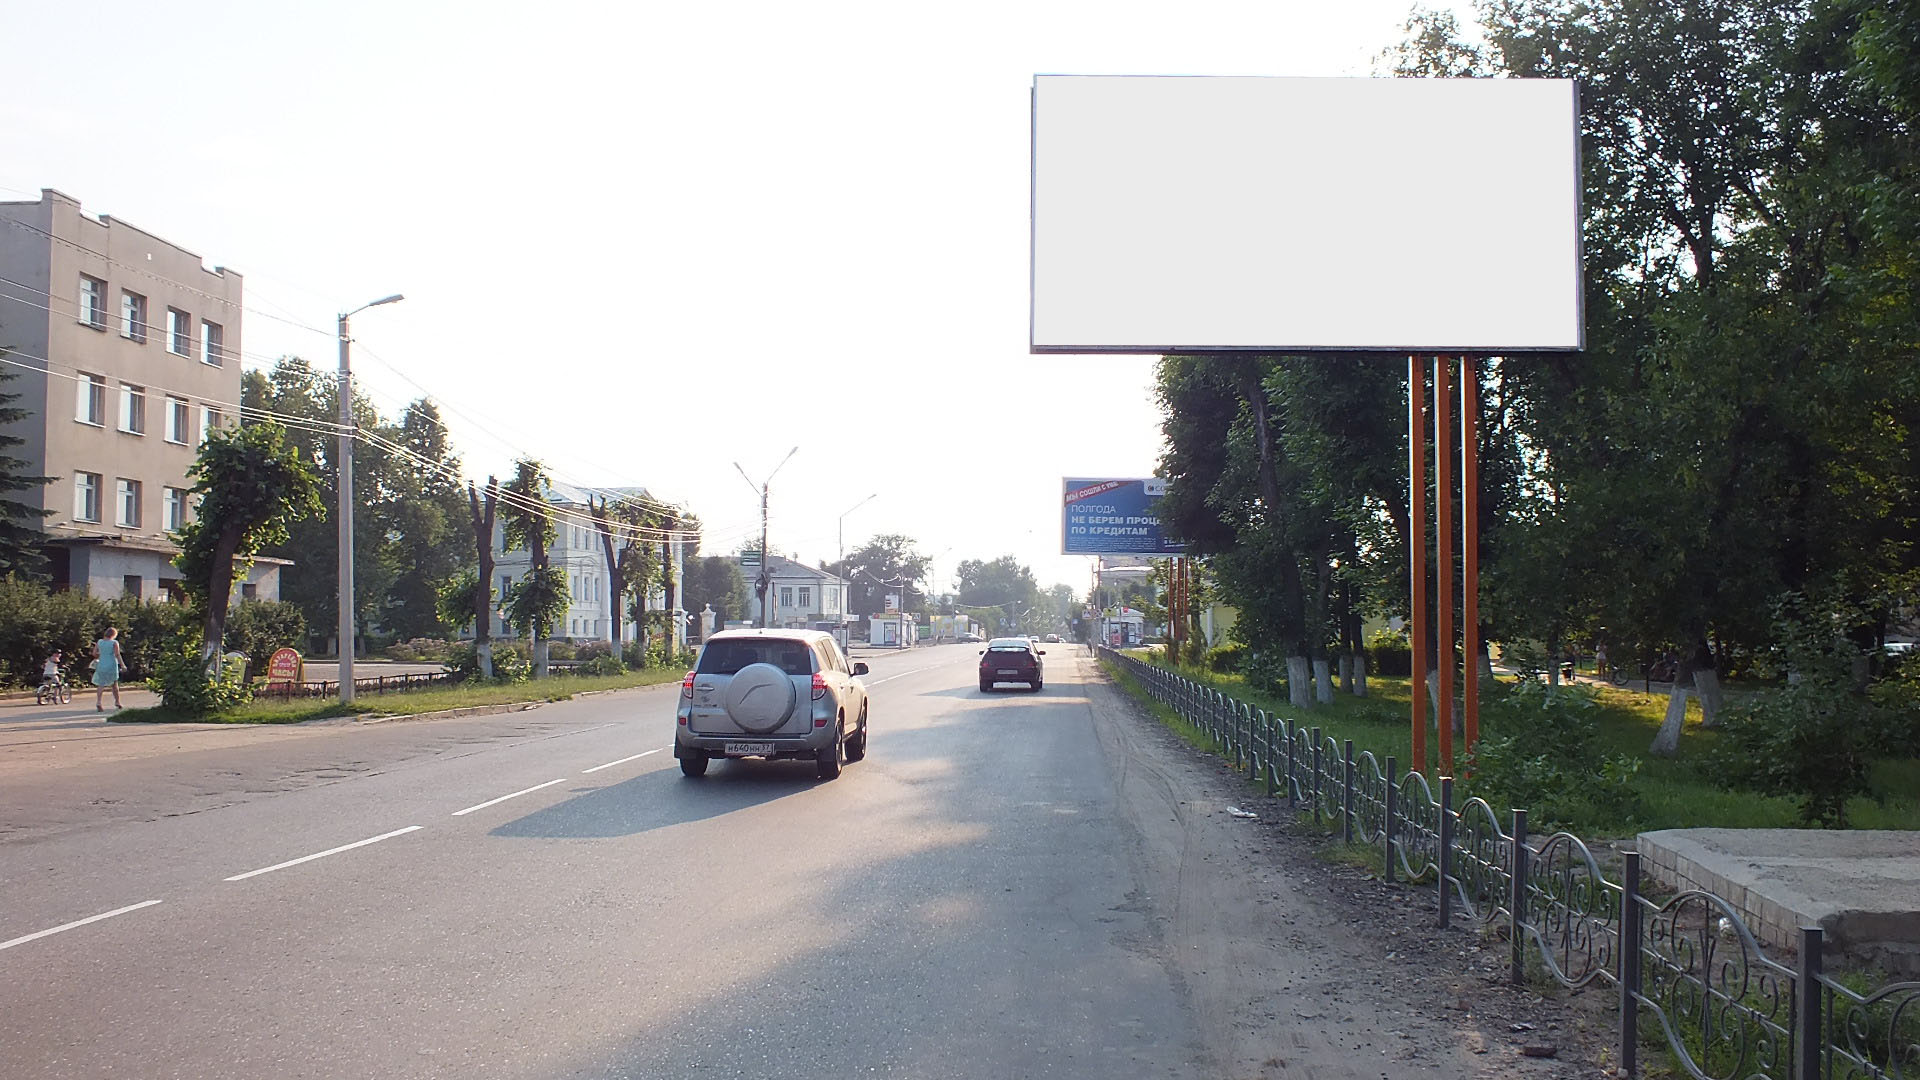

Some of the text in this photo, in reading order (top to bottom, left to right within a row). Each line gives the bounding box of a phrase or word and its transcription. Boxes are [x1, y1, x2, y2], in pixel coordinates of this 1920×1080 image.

[1066, 492, 1079, 502] МЫ
[1079, 485, 1102, 498] СОШЛИ
[1071, 504, 1117, 514] ПОЛГОДА
[1071, 515, 1086, 524] НЕ
[1088, 516, 1124, 524] БЕРЕМ
[1071, 526, 1087, 534] ПО
[272, 669, 295, 677] ЧАСЫ
